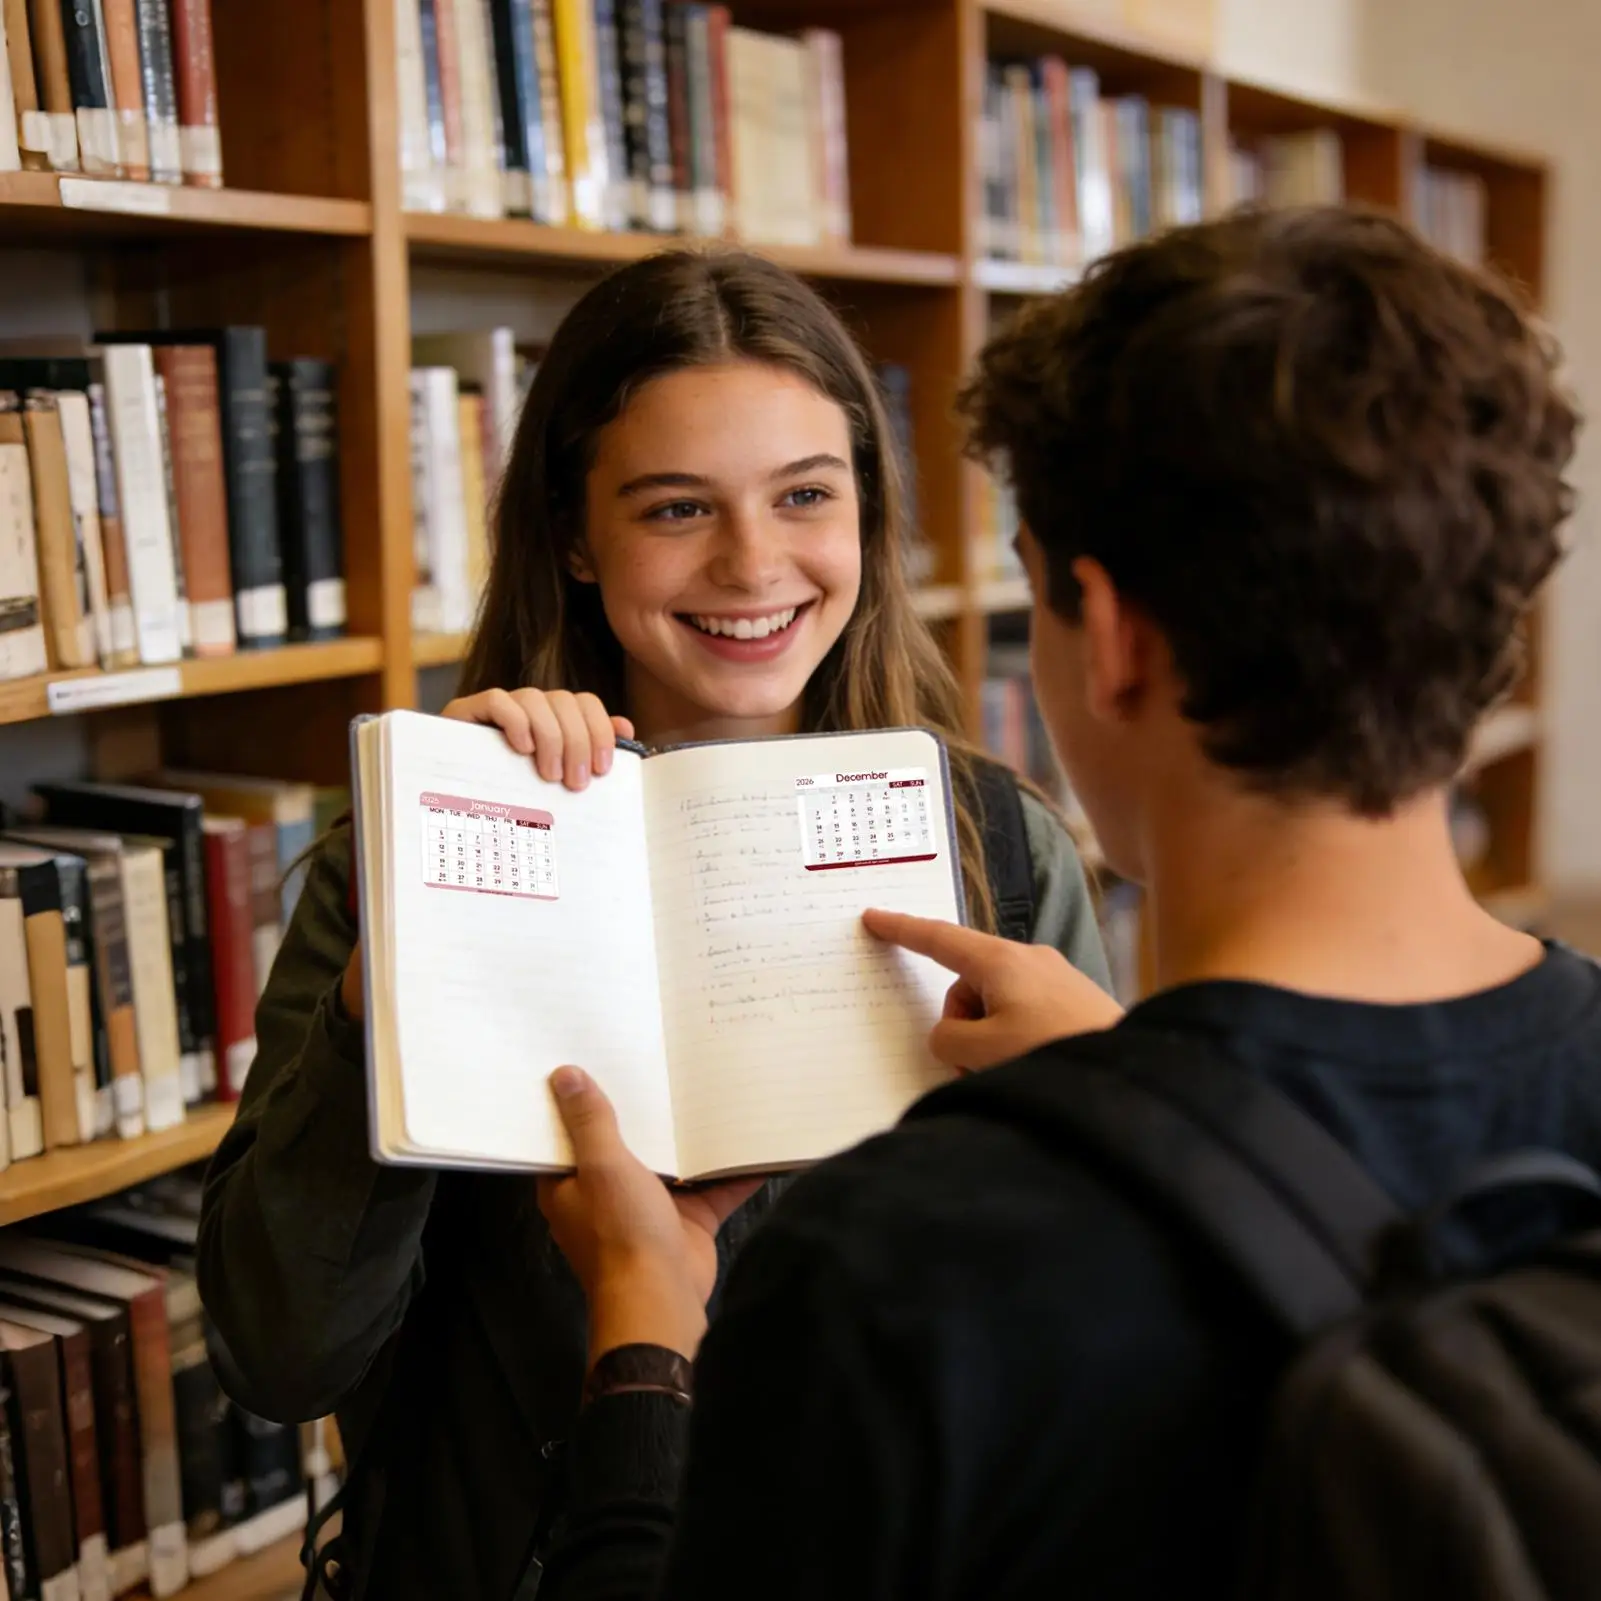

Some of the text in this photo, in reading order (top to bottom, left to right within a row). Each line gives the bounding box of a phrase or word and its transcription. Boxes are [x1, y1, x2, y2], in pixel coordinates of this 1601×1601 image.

[796, 771, 888, 786] 2026 December
[470, 801, 511, 816] January
